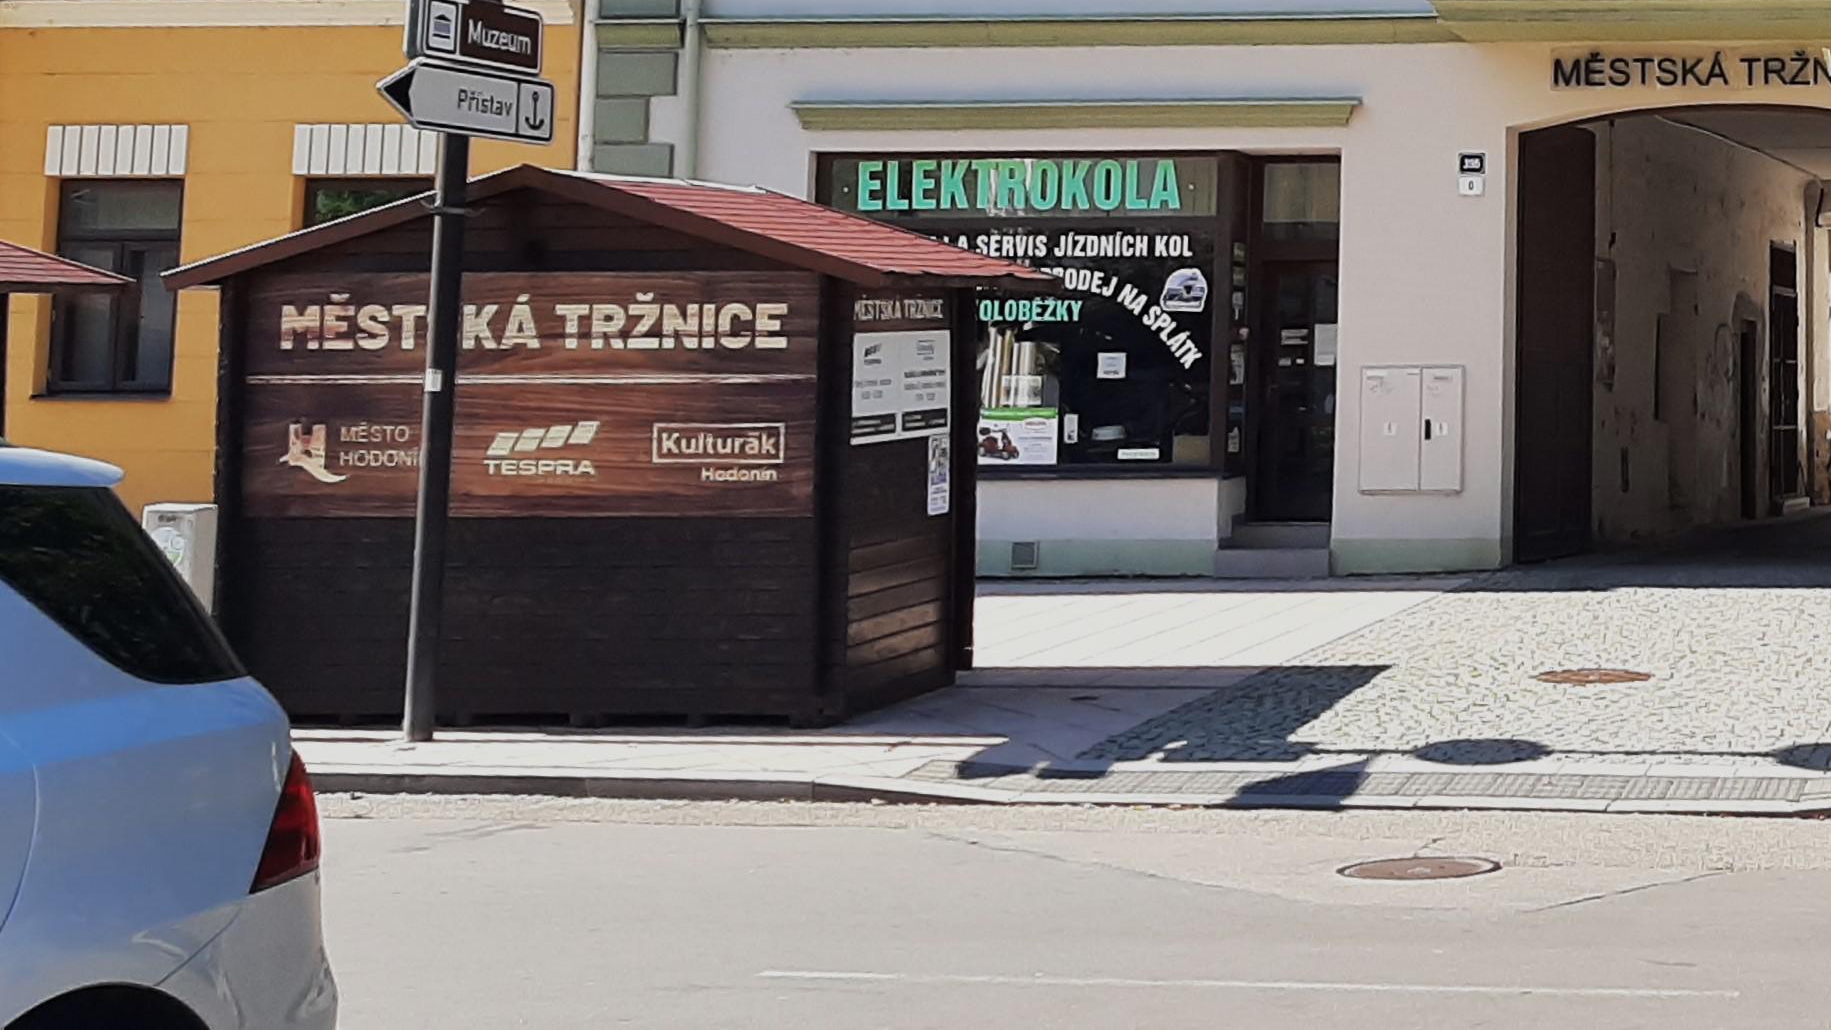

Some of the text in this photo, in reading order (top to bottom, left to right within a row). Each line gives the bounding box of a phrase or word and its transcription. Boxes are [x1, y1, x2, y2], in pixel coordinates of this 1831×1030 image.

[468, 18, 531, 55] Muzeum
[1552, 51, 1729, 86] MĚSTSKÁ
[457, 89, 512, 117] Přístav
[857, 159, 1181, 211] ELEKTROKOLA
[976, 234, 1048, 258] SERVIS
[1053, 231, 1150, 258] JÍZDNÍCH
[1154, 234, 1193, 258] KOL
[1040, 267, 1119, 297] ODEJ
[1117, 283, 1148, 316] NA
[280, 291, 788, 350] MĚSTKÁ TRŽNICE
[977, 296, 1083, 322] OLOBĚŽKY
[339, 421, 410, 443] MĚSTO
[339, 446, 423, 467] HODONÍ
[483, 459, 596, 477] TESPRA
[701, 466, 777, 482] Hodonín
